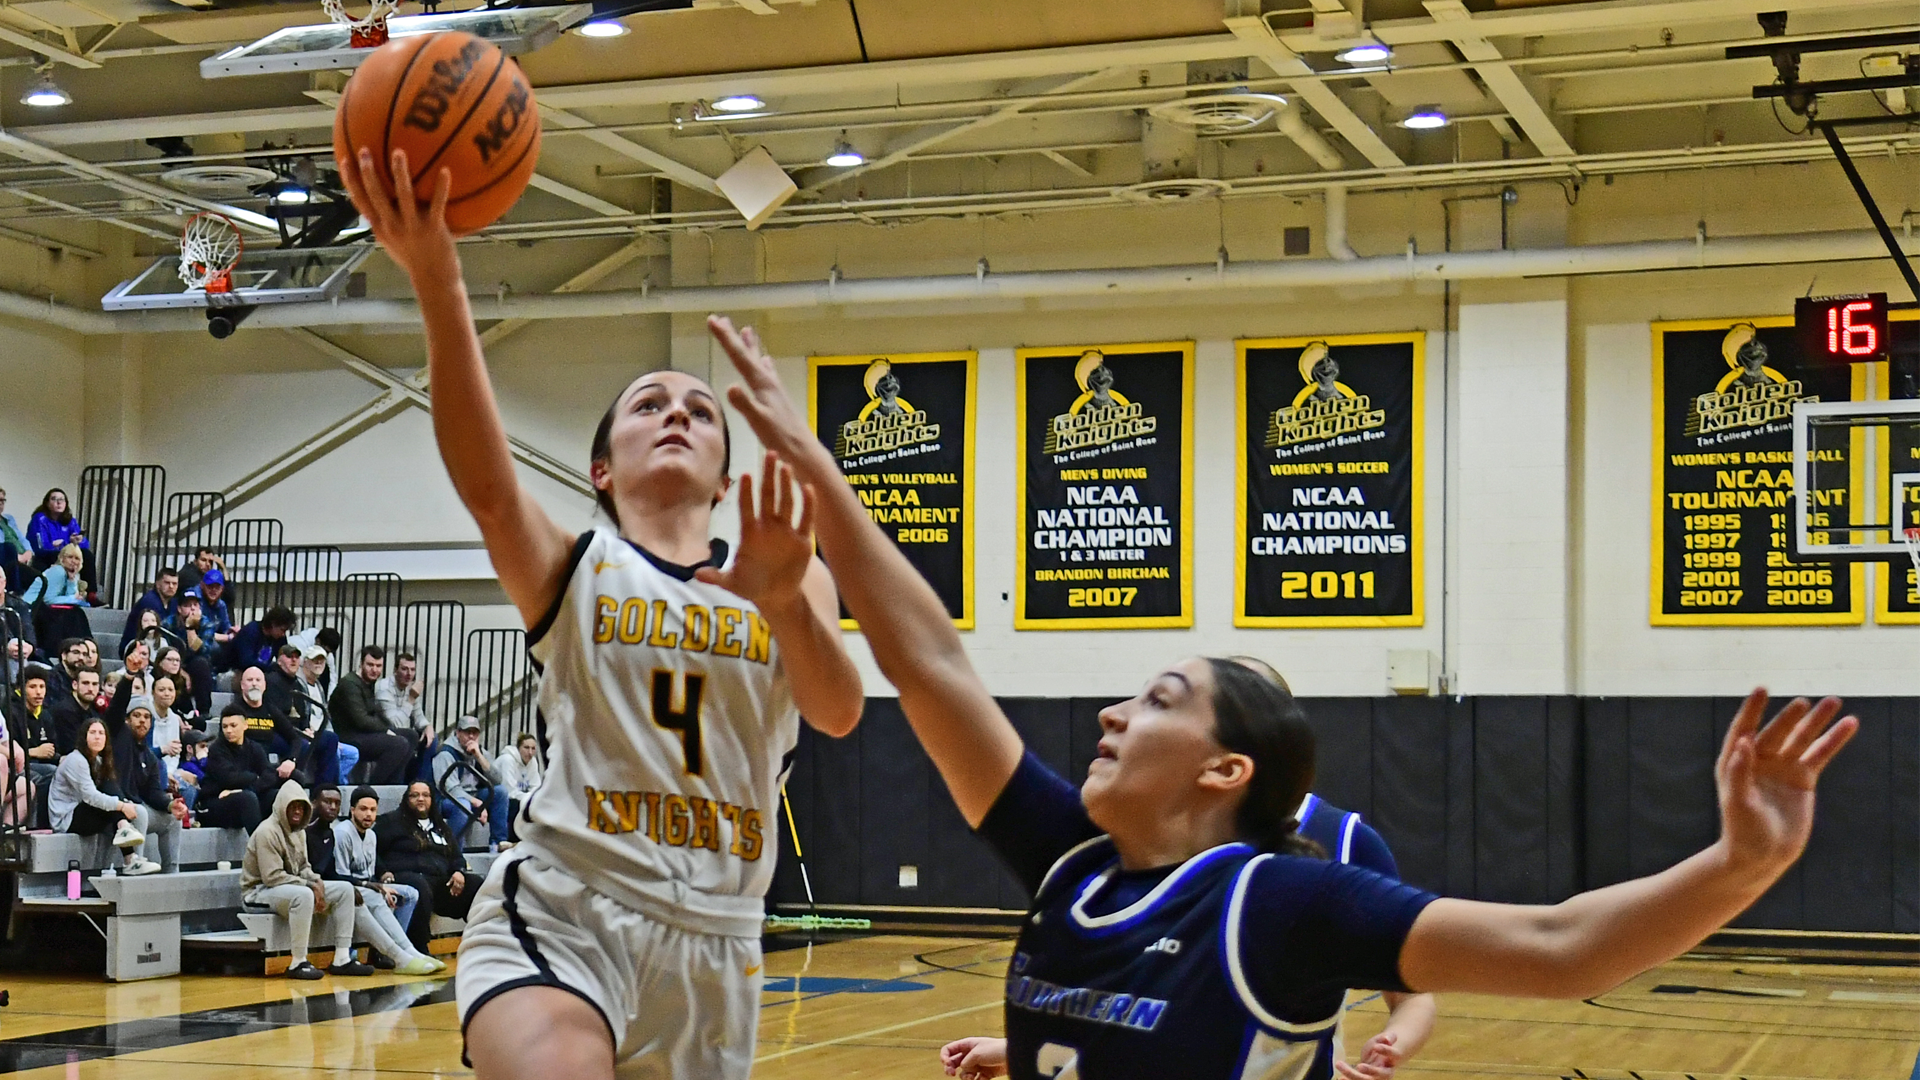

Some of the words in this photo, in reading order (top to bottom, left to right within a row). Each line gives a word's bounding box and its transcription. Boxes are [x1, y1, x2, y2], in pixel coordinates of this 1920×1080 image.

[403, 40, 484, 133] Wilson
[474, 75, 529, 164] NCAA
[1828, 302, 1876, 355] 16
[1697, 380, 1802, 414] Golden
[1054, 402, 1143, 433] Golden
[1276, 395, 1370, 426] Golden
[1699, 395, 1820, 434] Knight
[844, 410, 927, 440] Golden
[1056, 416, 1157, 452] Knights
[1278, 409, 1386, 446] Knights
[845, 424, 940, 457] Knights
[1275, 449, 1292, 459] The
[1293, 442, 1325, 455] College
[1326, 439, 1336, 447] of
[1337, 435, 1361, 446] Saint
[1363, 430, 1386, 441] Rose
[1697, 436, 1714, 447] The
[1716, 429, 1752, 443] College
[1753, 426, 1764, 435] of
[843, 460, 857, 469] The
[858, 454, 887, 466] College
[887, 451, 897, 460] of
[897, 447, 919, 458] Saint
[920, 443, 941, 453] Rose
[1053, 455, 1069, 464] The
[1069, 448, 1100, 461] College
[1101, 445, 1111, 454] of
[1111, 441, 1135, 452] Saint
[1135, 437, 1157, 447] Rose
[1671, 452, 1740, 467] WOMEN'S
[1745, 449, 1844, 465] BASKEBALL
[843, 473, 879, 485] MEN'S
[882, 473, 958, 485] VOLLEYBALL
[1060, 469, 1099, 481] MEN'S
[1102, 467, 1148, 480] DIVING
[1269, 462, 1334, 475] WOMEN'S
[1337, 461, 1389, 474] SOCCER
[1716, 469, 1794, 489] NCAA
[857, 488, 921, 507] NCAA
[1066, 485, 1139, 506] NCAA
[1292, 486, 1365, 507] NCAA
[866, 507, 961, 524] NAMENT
[1037, 506, 1169, 528] NATIONAL
[1262, 510, 1395, 532] NATIONAL
[1683, 513, 1741, 531] 1995
[897, 528, 949, 543] 2006
[1033, 527, 1172, 550] CHAMPION
[1251, 534, 1407, 556] CHAMPIONS
[1683, 532, 1741, 550] 1997
[1059, 550, 1067, 562] 1
[1070, 550, 1083, 562] &
[1085, 549, 1095, 562] 3
[1098, 549, 1145, 561] METER
[1683, 551, 1741, 569] 1999
[1034, 569, 1104, 582] BRANDON
[1107, 567, 1170, 580] BIRCHAK
[1281, 571, 1375, 599] 2011
[1682, 570, 1740, 588] 2001
[1766, 569, 1833, 587] 2006
[1068, 587, 1138, 607] 2007
[1680, 589, 1743, 607] 2007
[1767, 588, 1833, 606] 2009
[593, 595, 771, 665] GOLDEN
[651, 667, 706, 778] 4
[584, 785, 764, 861] KNIGHTS
